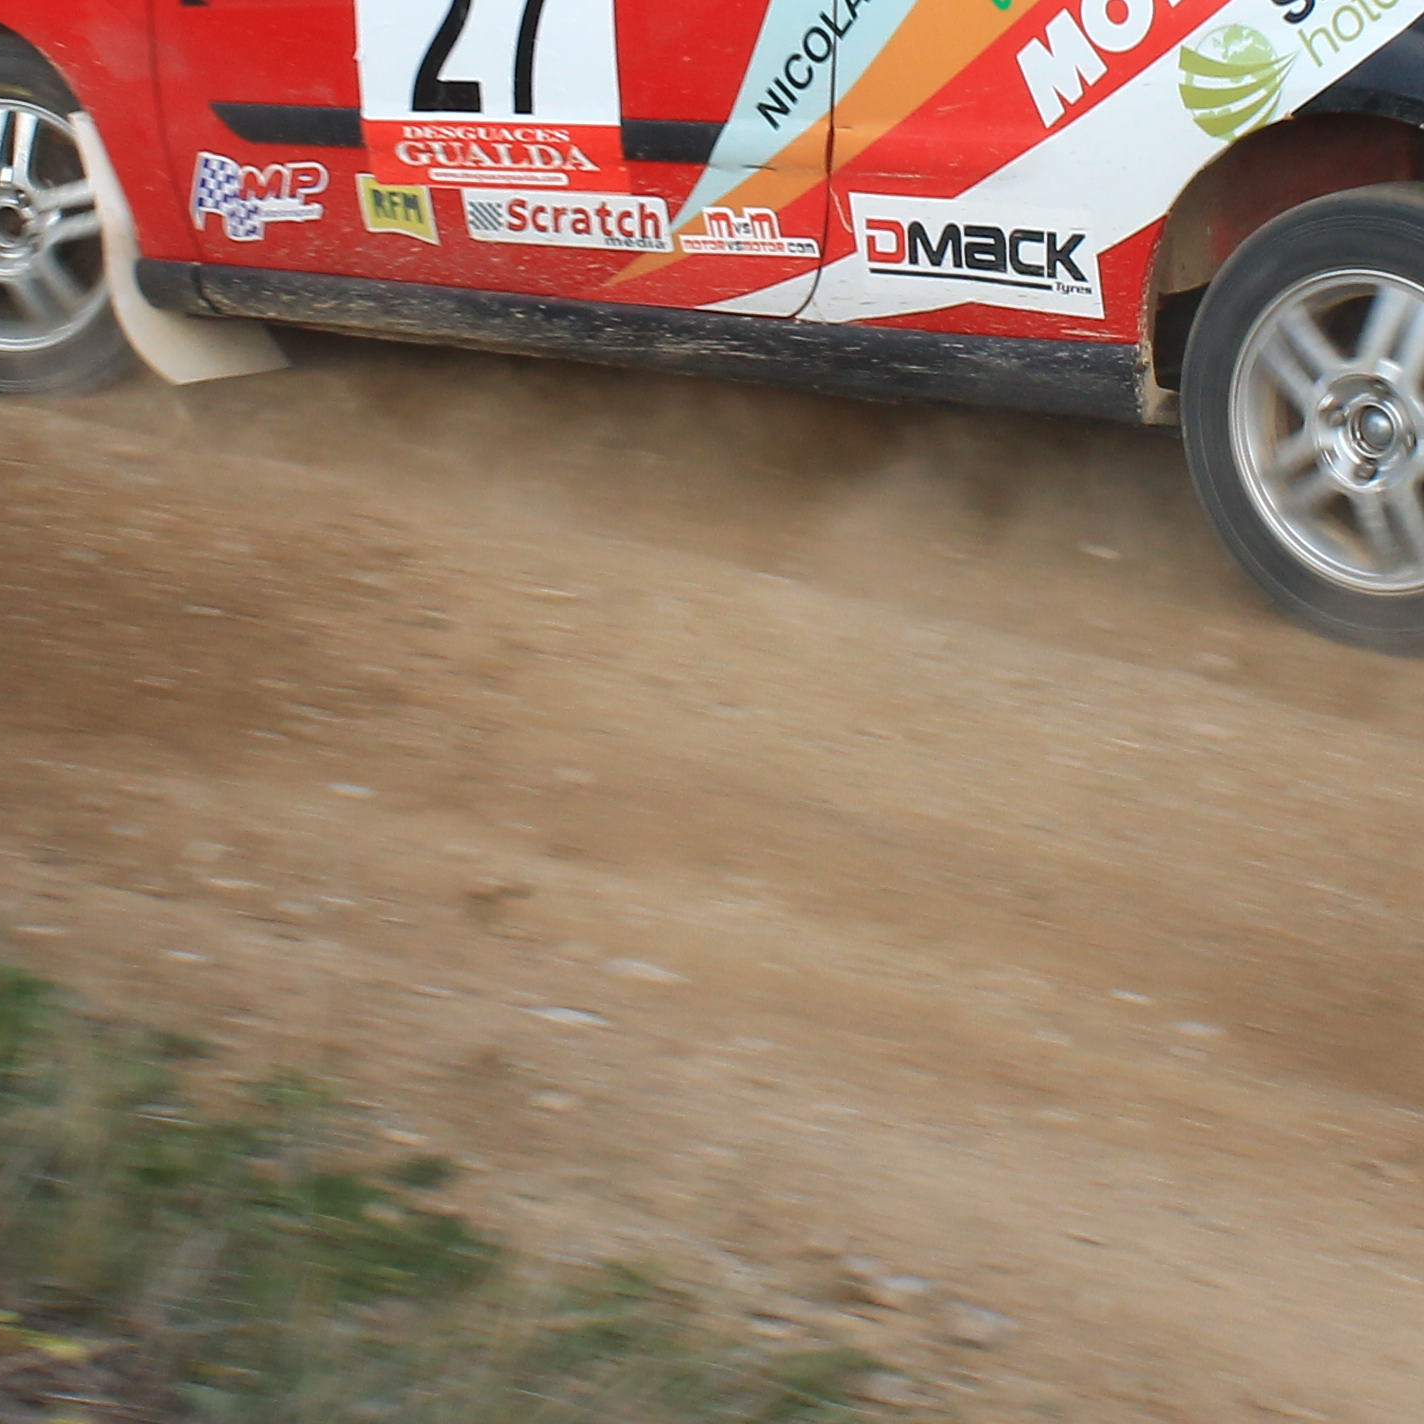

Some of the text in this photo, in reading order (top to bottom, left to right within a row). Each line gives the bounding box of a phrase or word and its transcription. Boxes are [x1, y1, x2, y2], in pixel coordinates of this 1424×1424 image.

[402, 125, 571, 143] DESGUACES
[394, 140, 601, 172] GUALDA
[506, 198, 662, 240] Scratch
[604, 236, 668, 252] media
[865, 217, 1089, 282] DMACK
[1055, 281, 1093, 296] Tyres
